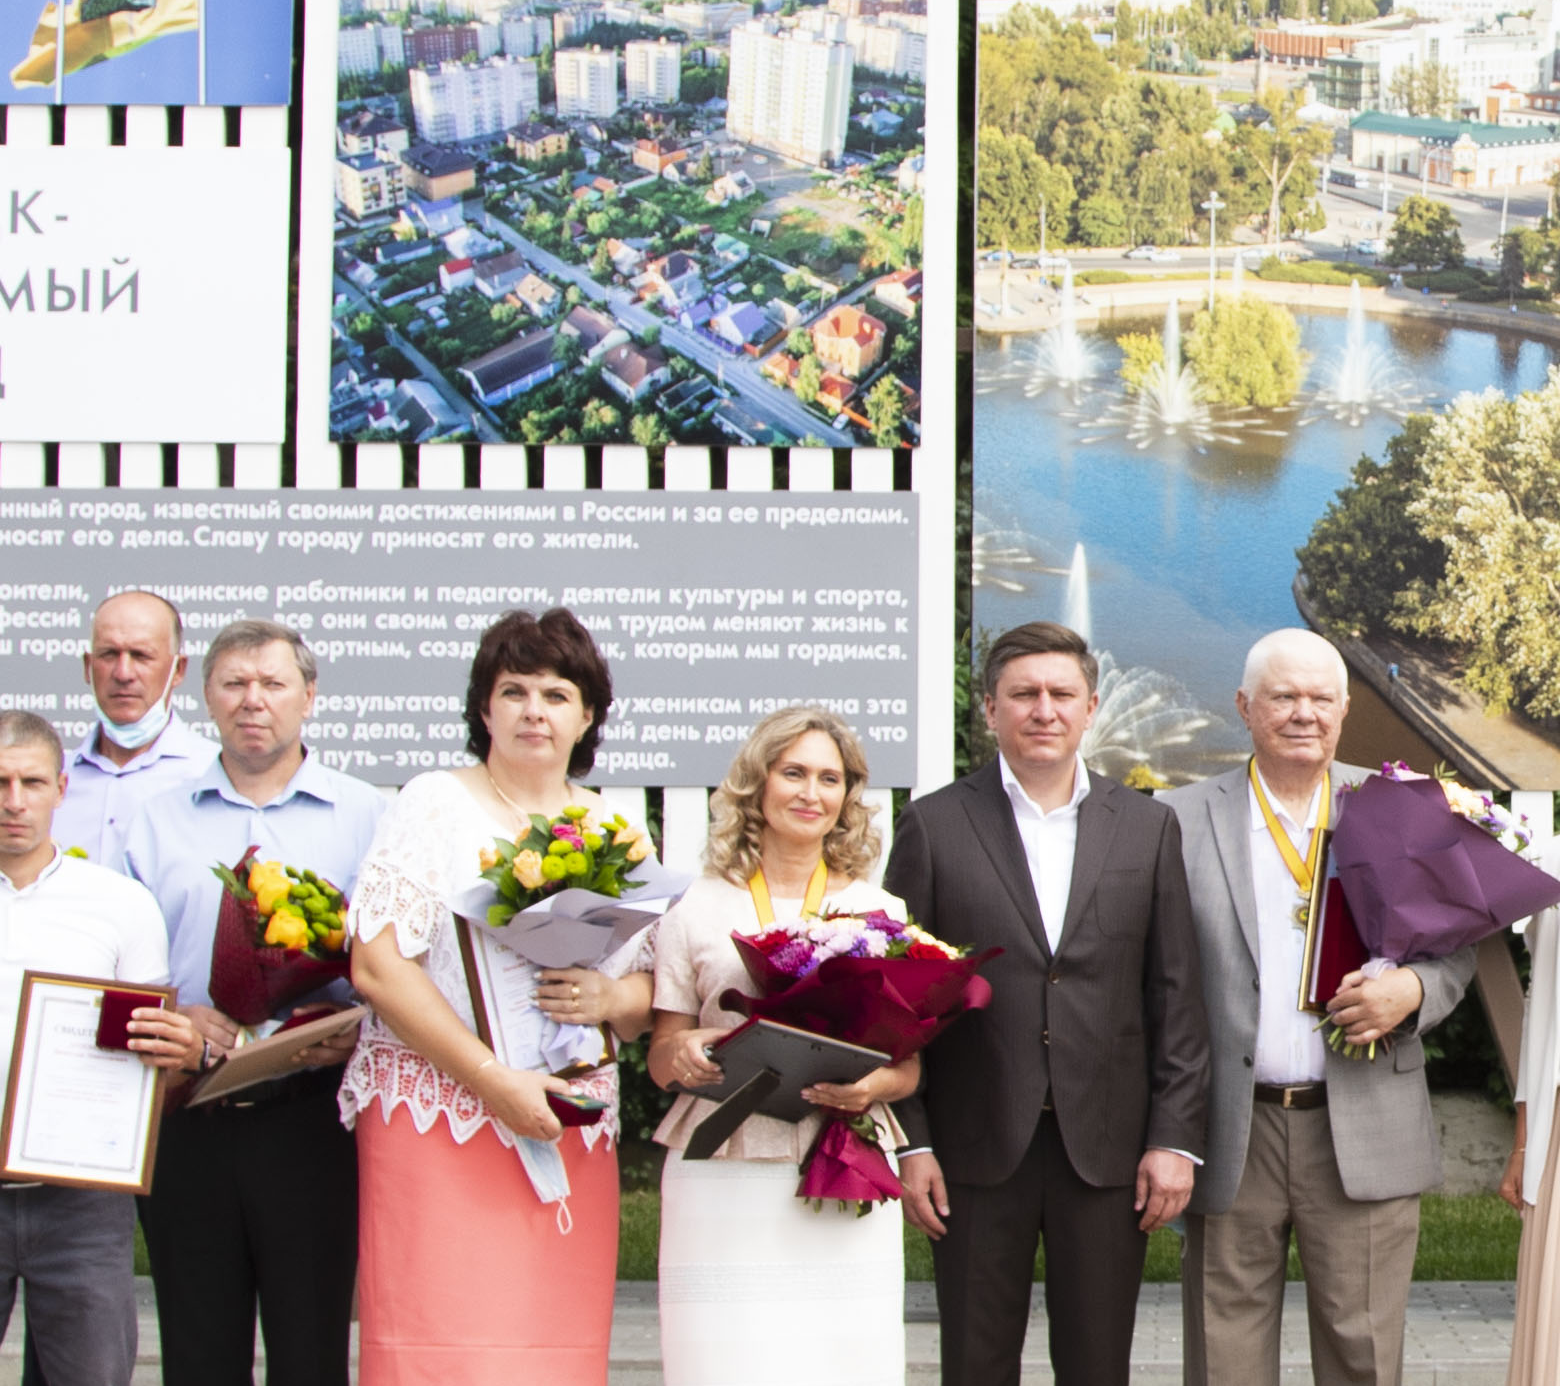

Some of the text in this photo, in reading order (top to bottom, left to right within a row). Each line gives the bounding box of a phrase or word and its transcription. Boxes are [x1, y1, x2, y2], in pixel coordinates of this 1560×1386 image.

[70, 502, 146, 524] город,
[154, 499, 280, 519] известный
[288, 502, 373, 520] своими
[379, 504, 556, 522] достижениями
[564, 505, 575, 521] в
[583, 501, 666, 522] России
[672, 507, 687, 522] и
[694, 507, 721, 523] за
[729, 507, 758, 523] ее
[765, 507, 909, 530] пределами.
[72, 529, 113, 546] его
[121, 529, 190, 548] дела.
[194, 525, 269, 554] Славу
[278, 530, 362, 554] городу
[372, 531, 485, 554] приносят
[493, 532, 534, 549] его
[543, 531, 638, 550] жители.
[277, 579, 405, 608] работники
[415, 585, 428, 602] и
[437, 585, 553, 605] педагоги,
[562, 586, 660, 605] деятели
[669, 588, 783, 611] культуры
[792, 589, 806, 604] и
[815, 588, 908, 612] спорта,
[321, 613, 367, 629] они
[375, 613, 447, 630] своим
[620, 615, 705, 638] трудом
[713, 616, 804, 633] меняют
[812, 616, 886, 633] жизнь
[895, 617, 908, 633] к
[635, 642, 737, 664] которым
[745, 643, 779, 660] мы
[788, 643, 907, 665] гордимся.
[313, 695, 465, 718] результатов.
[867, 697, 907, 714] эта
[353, 721, 420, 742] дела,
[642, 725, 700, 743] день
[870, 726, 907, 742] что
[594, 751, 676, 774] ердца.
